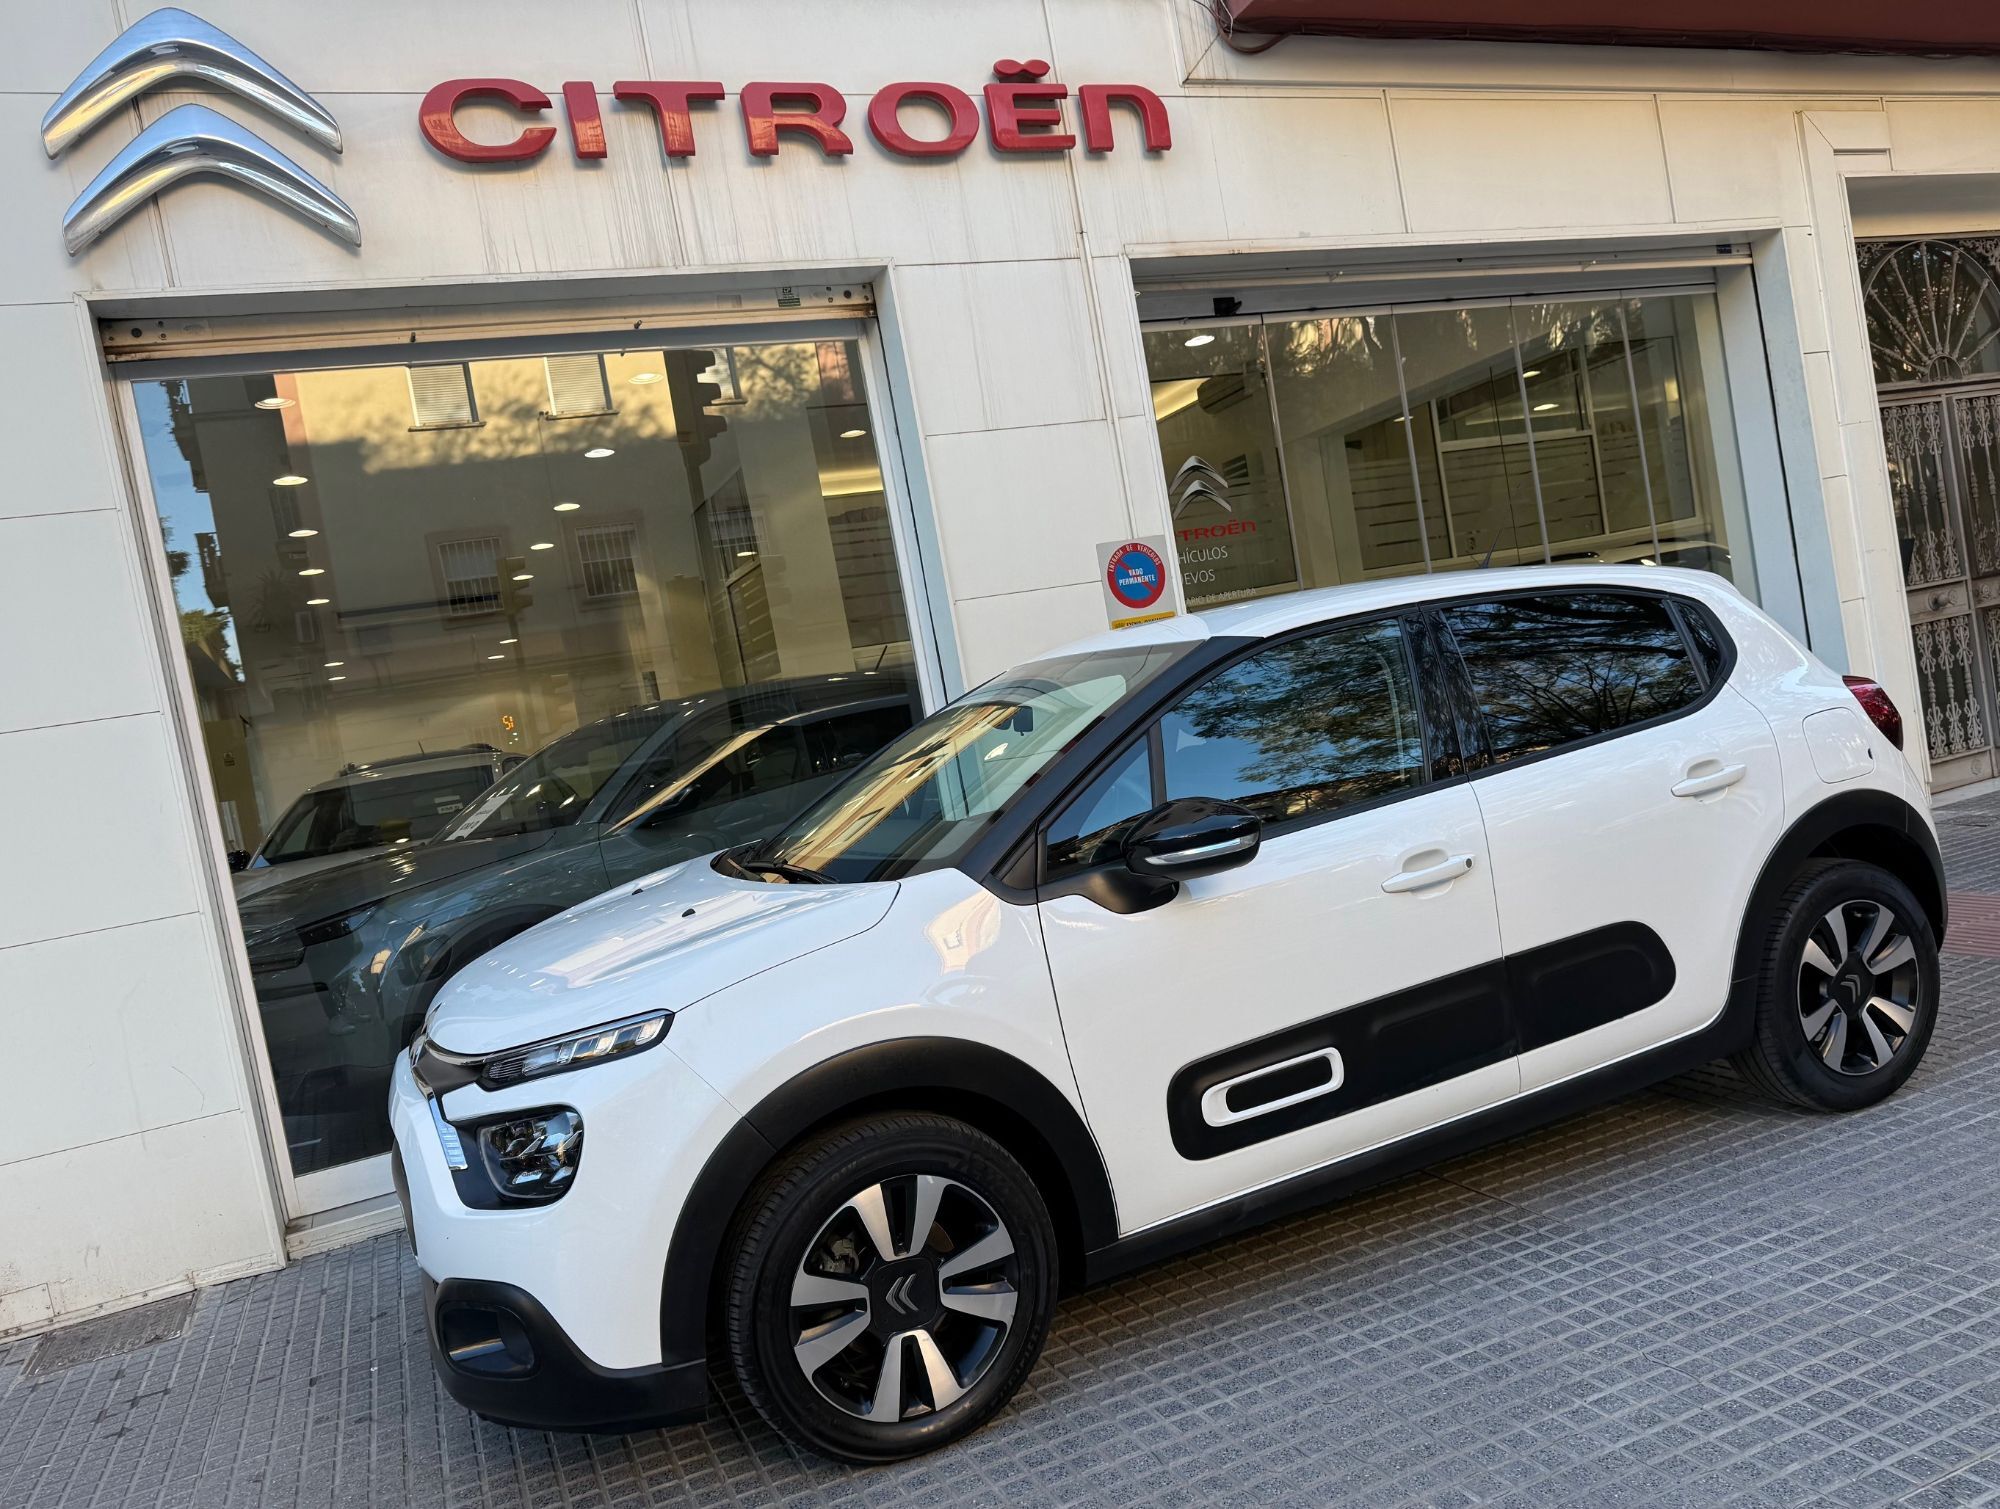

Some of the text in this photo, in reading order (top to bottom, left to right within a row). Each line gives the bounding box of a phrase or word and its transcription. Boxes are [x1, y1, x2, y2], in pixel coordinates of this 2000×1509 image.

[1178, 545, 1228, 564] HÍCULOS
[1128, 567, 1144, 576] VADO
[1182, 569, 1216, 585] EVOS
[1119, 574, 1156, 587] PERMANENTE
